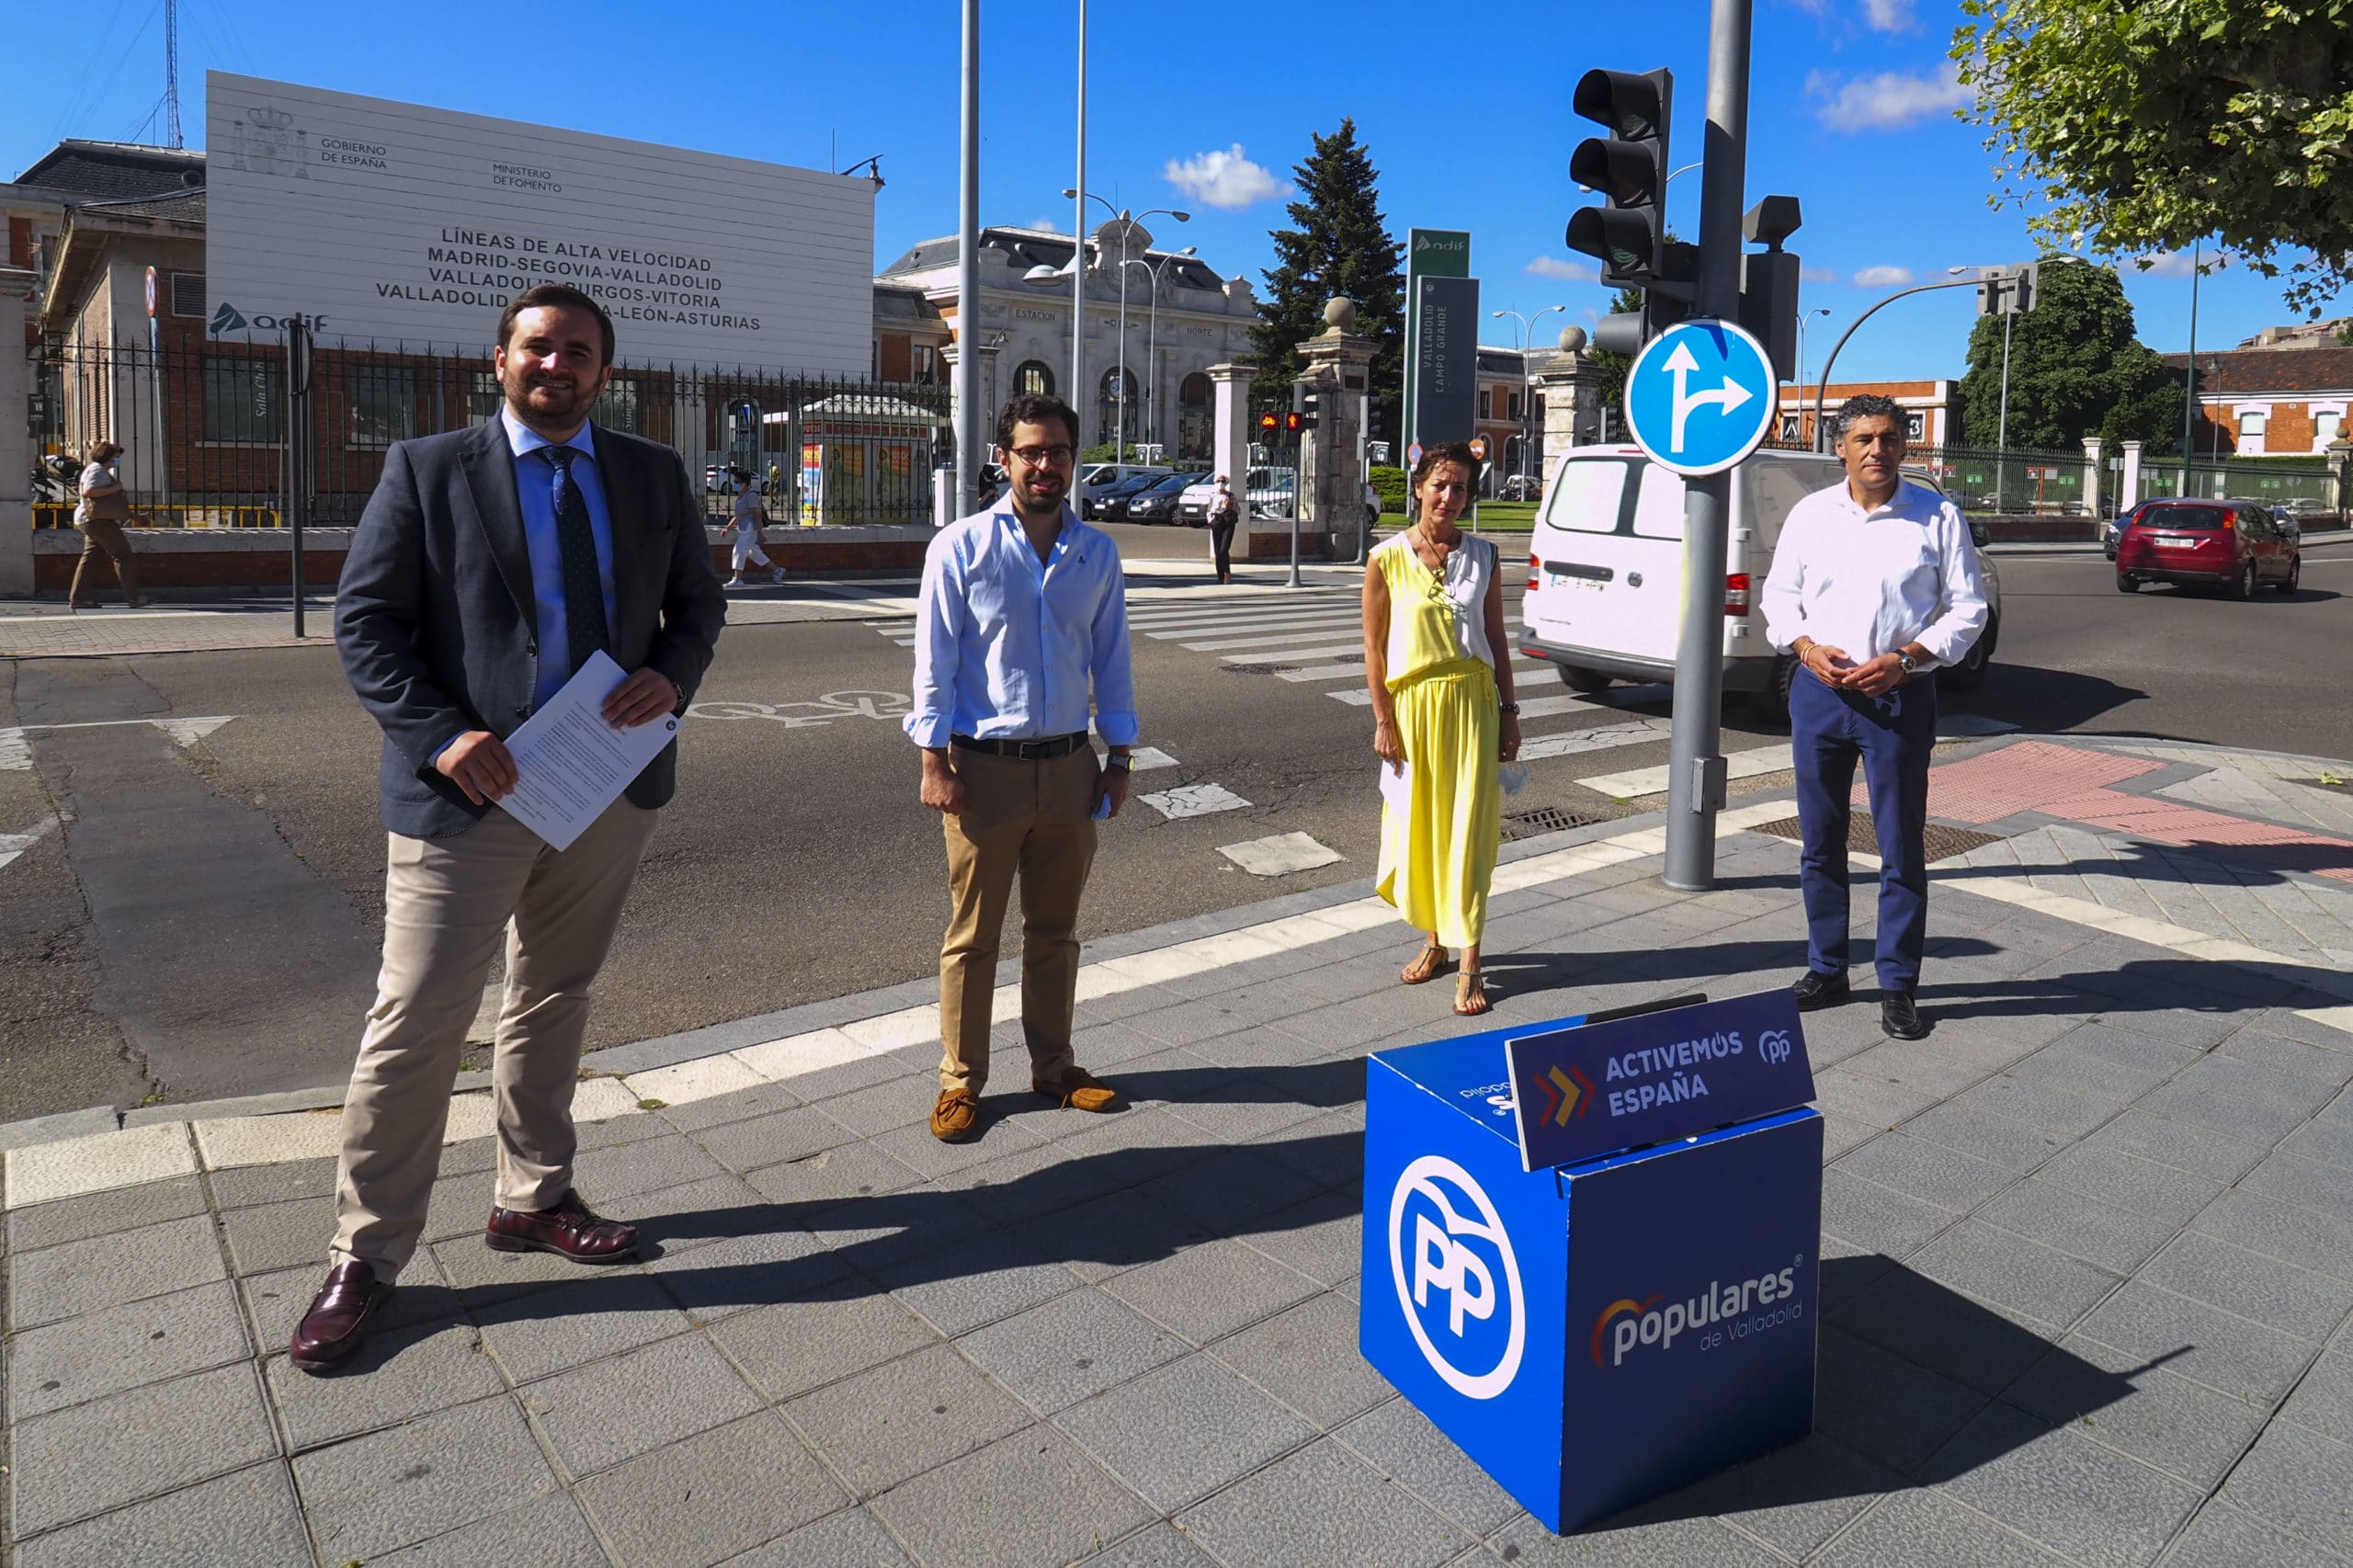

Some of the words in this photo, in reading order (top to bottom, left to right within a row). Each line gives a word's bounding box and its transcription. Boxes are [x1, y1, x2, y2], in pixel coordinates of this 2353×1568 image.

[322, 138, 386, 155] GOBIERNO
[322, 152, 337, 163] DE
[341, 153, 387, 169] ESPAÑA
[493, 163, 551, 179] MINISTERIO
[493, 176, 508, 186] DE
[509, 177, 563, 192] FOMENTO
[442, 227, 516, 249] LÍNEAS
[523, 238, 548, 254] DE
[554, 243, 602, 259] ALTA
[608, 248, 711, 271] VELOCIDAD
[1433, 241, 1464, 250] adif
[428, 247, 722, 290] MADRID-SEGOVIA-VALLADOLID
[253, 312, 330, 332] adif
[1187, 326, 1212, 336] NORTE
[1424, 304, 1434, 368] VALLADOLID
[1437, 305, 1447, 348] GRANDE
[1436, 354, 1445, 393] CAMPO
[1606, 1031, 1744, 1081] ACTIVEMOS
[1608, 1071, 1709, 1117] ESPAÑA
[1700, 1332, 1722, 1351] de
[1728, 1300, 1802, 1341] Valladolid
